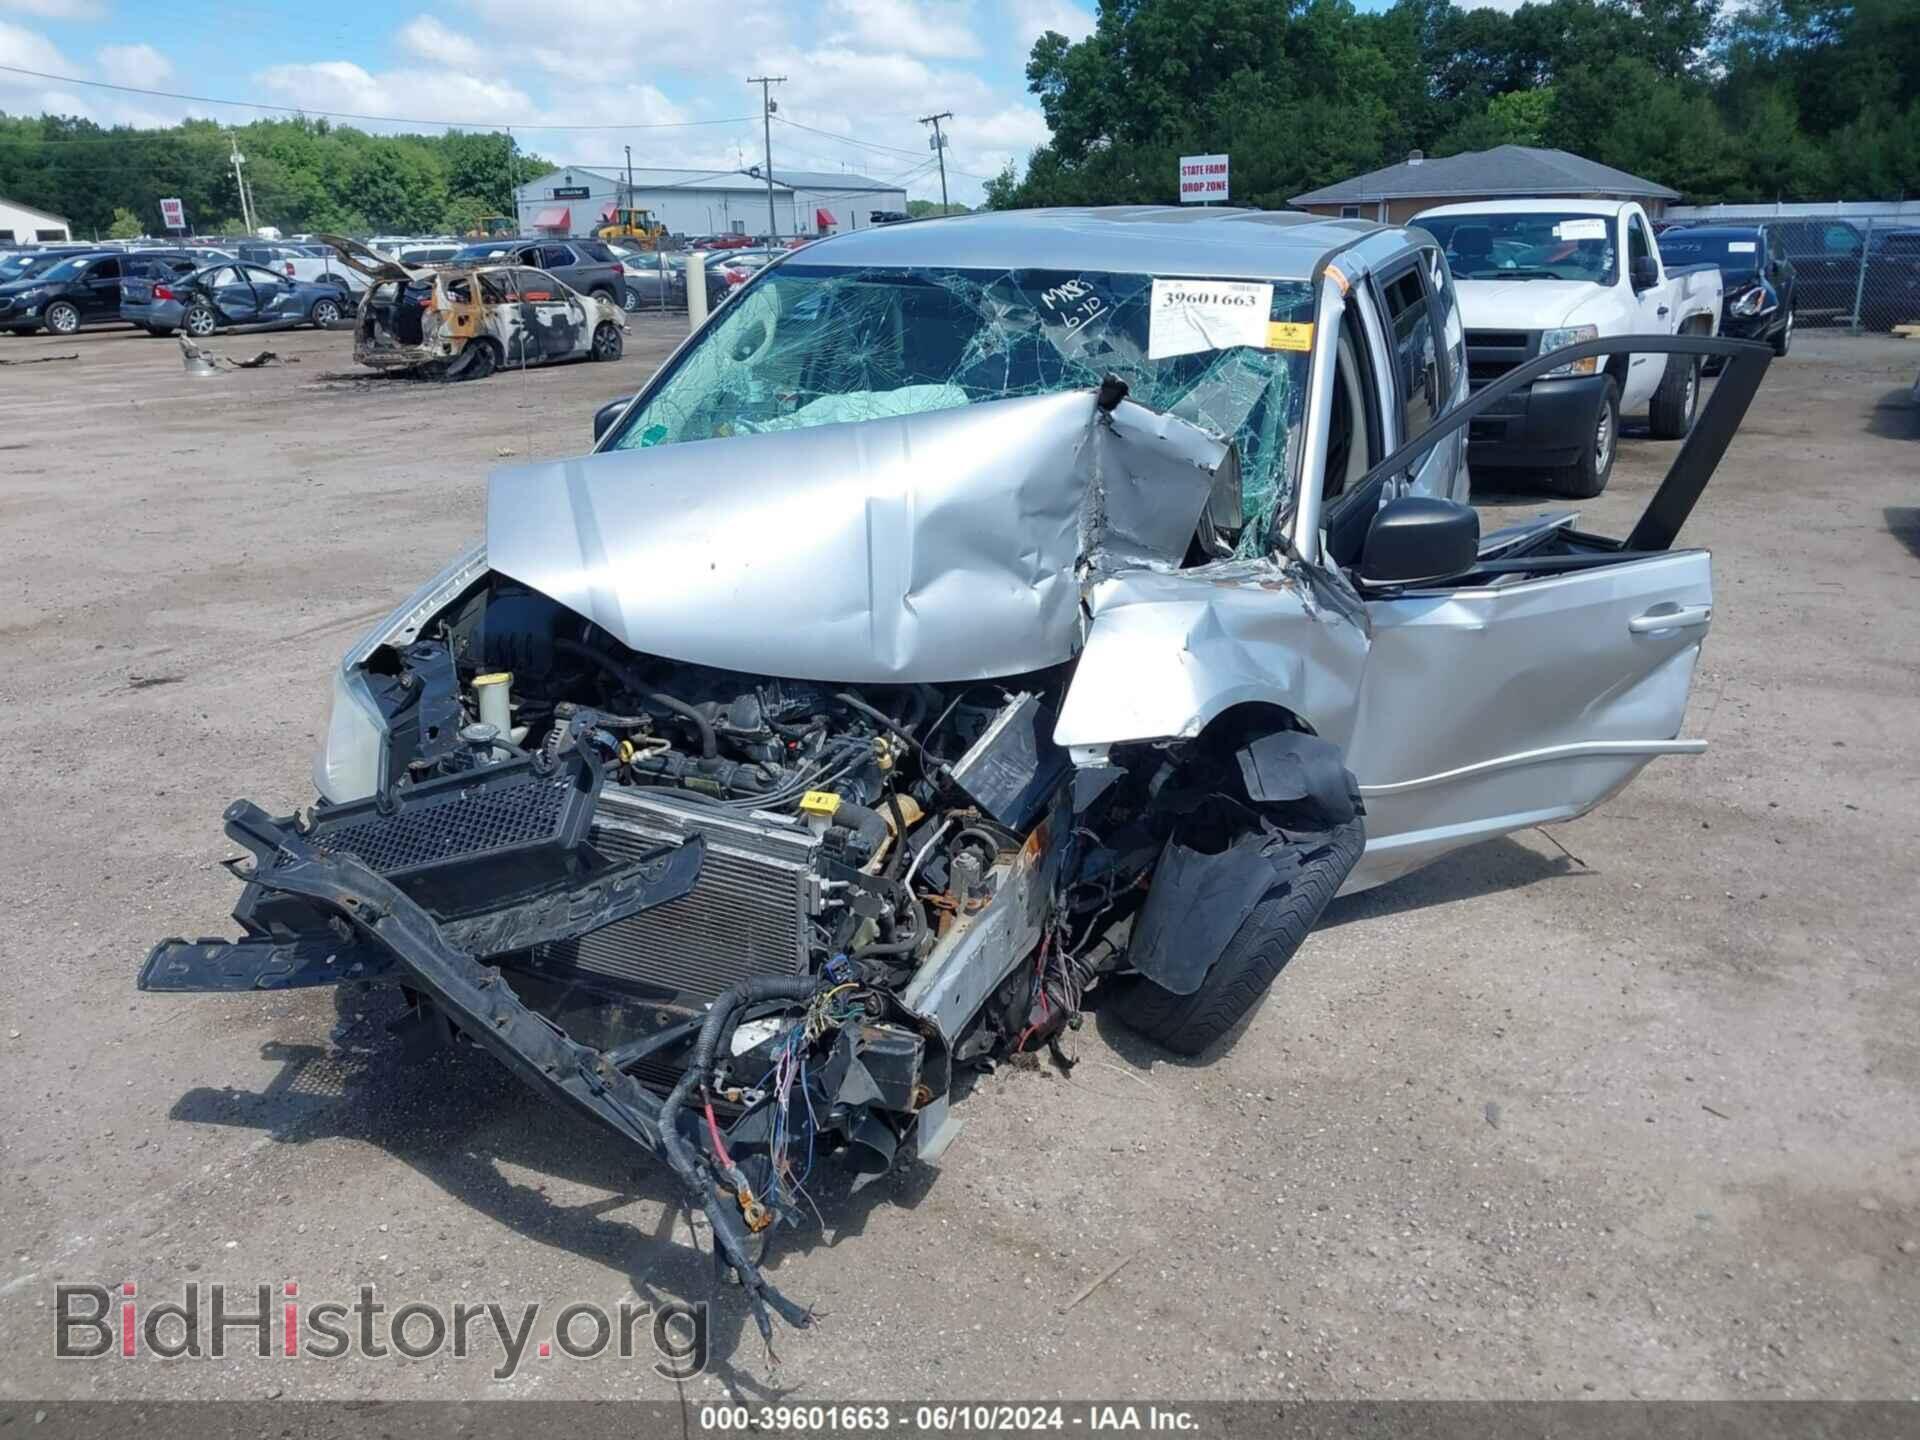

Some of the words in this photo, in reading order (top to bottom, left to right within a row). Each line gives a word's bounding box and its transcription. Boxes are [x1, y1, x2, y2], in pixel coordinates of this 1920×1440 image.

[1183, 164, 1204, 176] STATE
[1205, 163, 1226, 175] FARM
[1182, 182, 1204, 193] DROP
[1205, 180, 1226, 192] ZONE
[1163, 291, 1256, 307] 39601663
